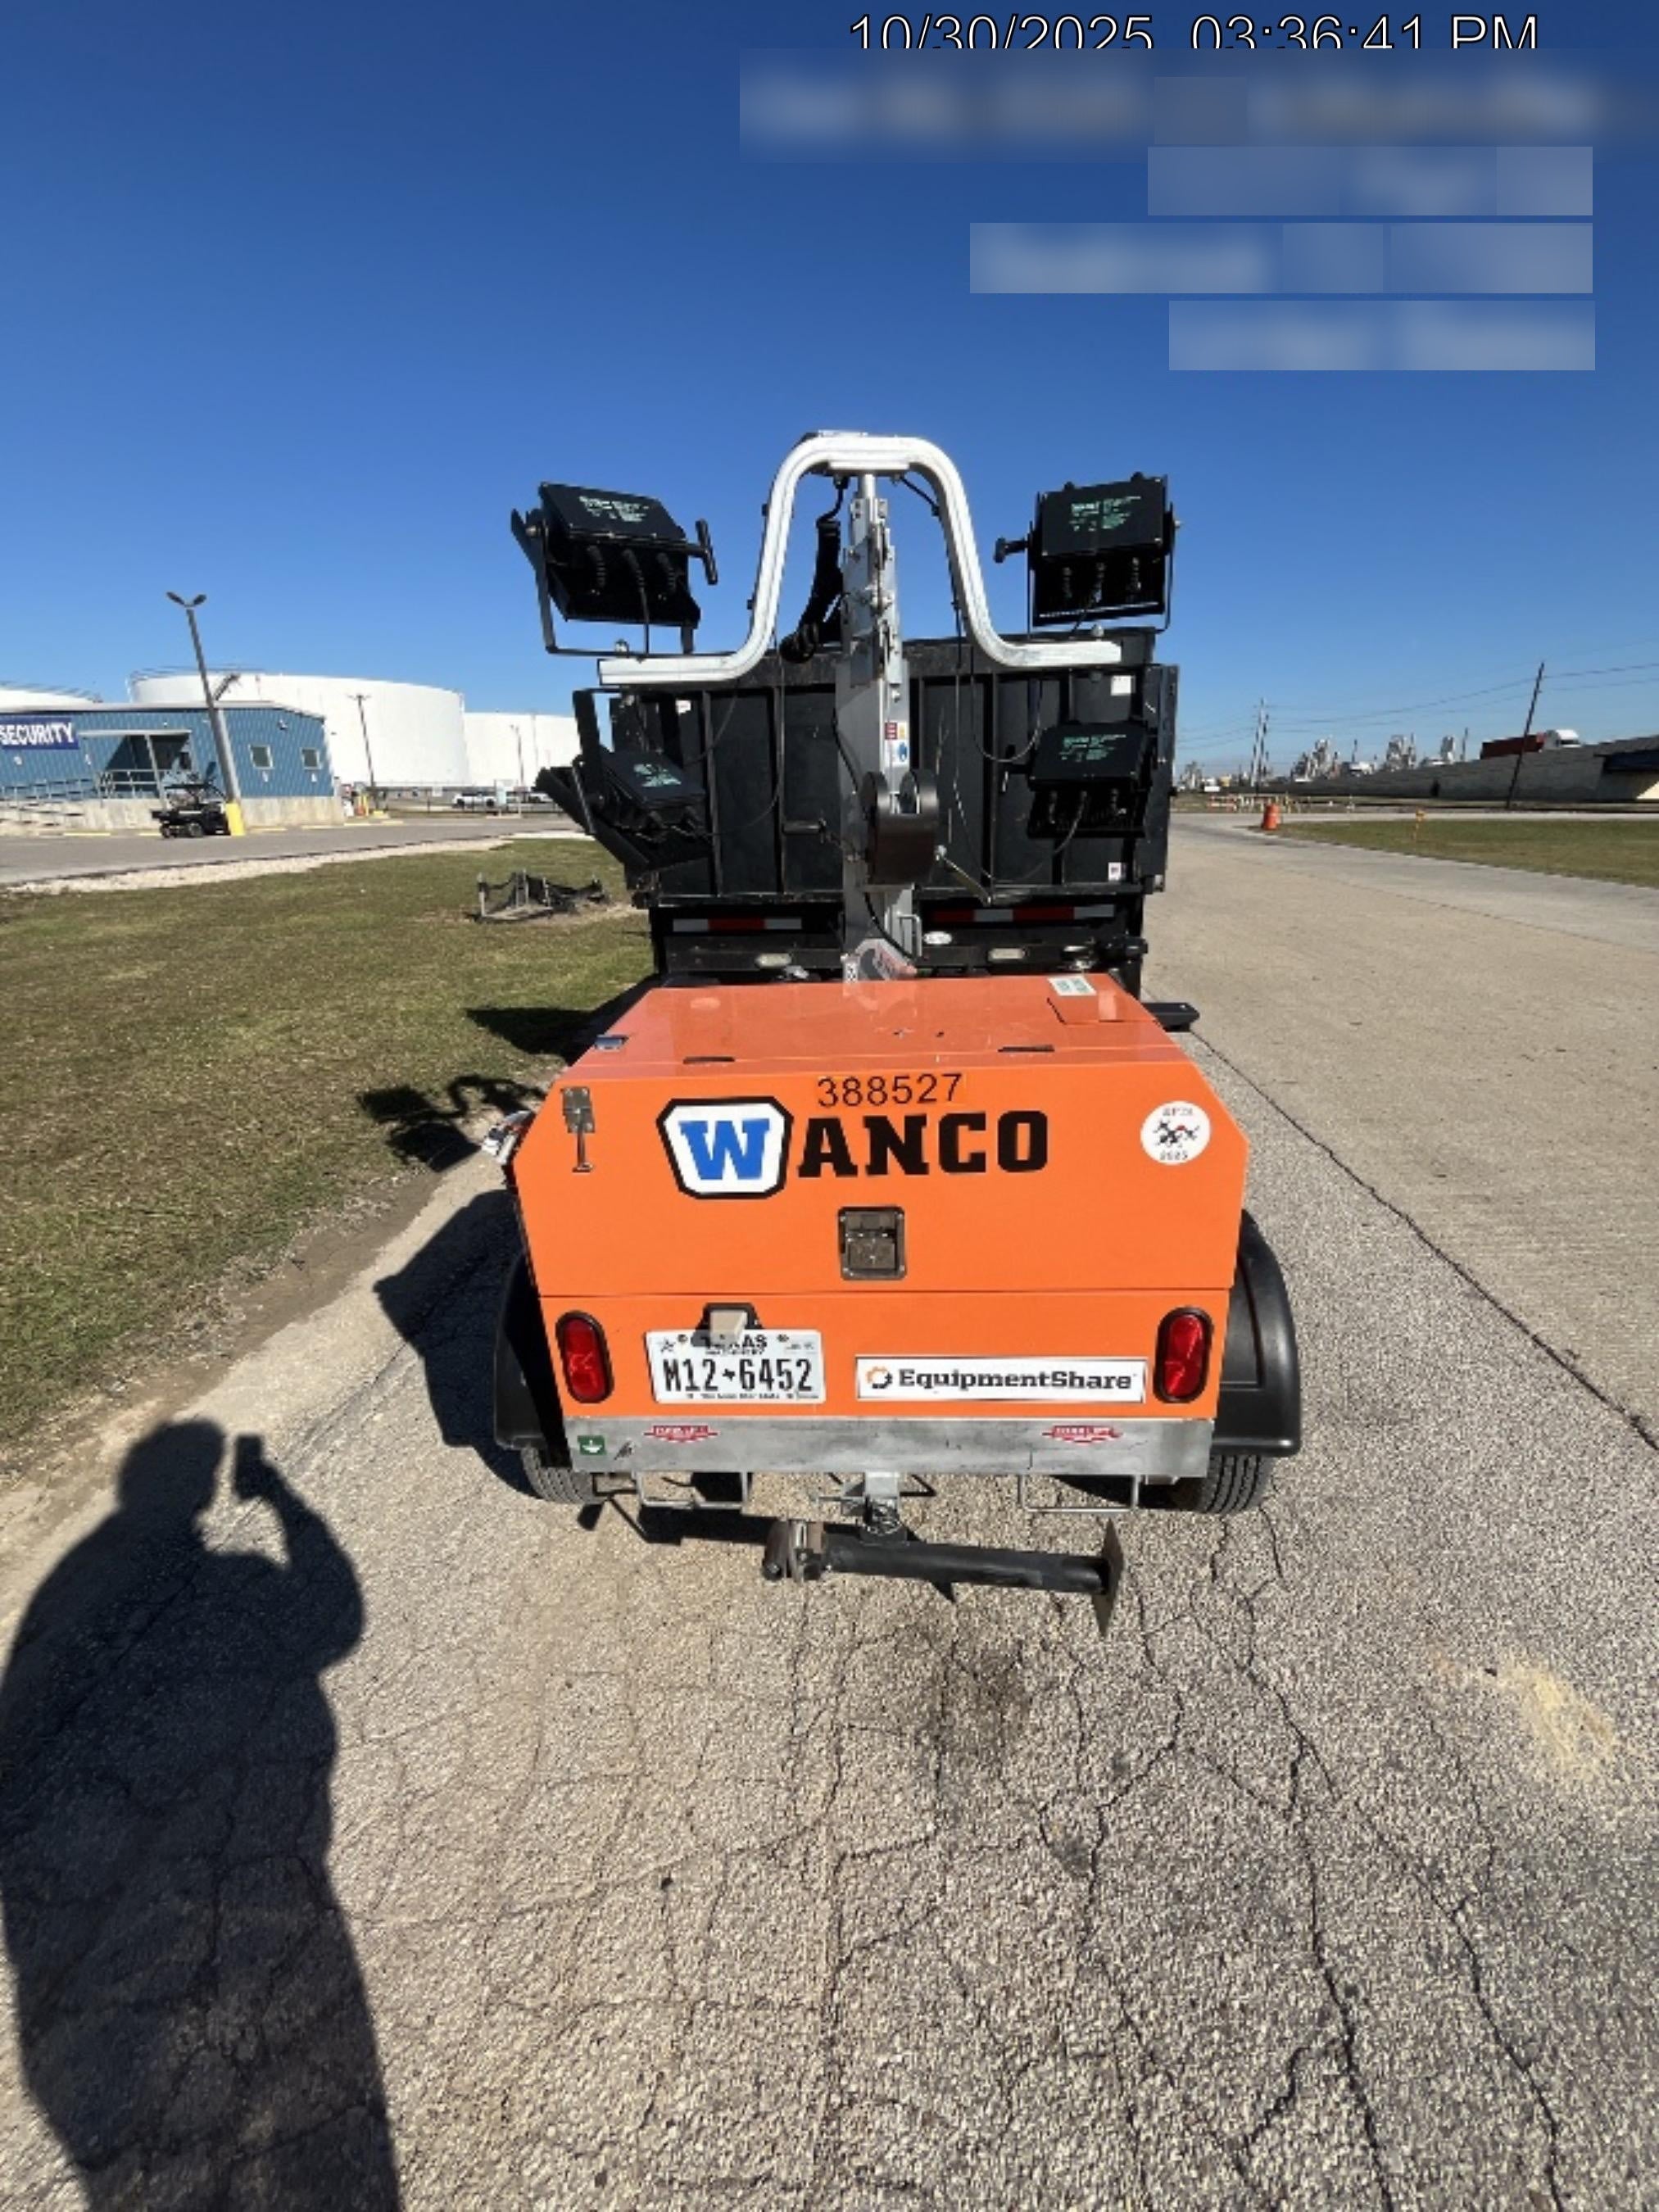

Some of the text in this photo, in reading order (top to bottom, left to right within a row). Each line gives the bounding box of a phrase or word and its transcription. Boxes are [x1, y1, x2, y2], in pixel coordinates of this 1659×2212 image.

[0, 722, 75, 746] SECURITY
[818, 1072, 963, 1108] 388527
[678, 1110, 1049, 1181] WANCO
[898, 1368, 1133, 1392] EquipmentShare
